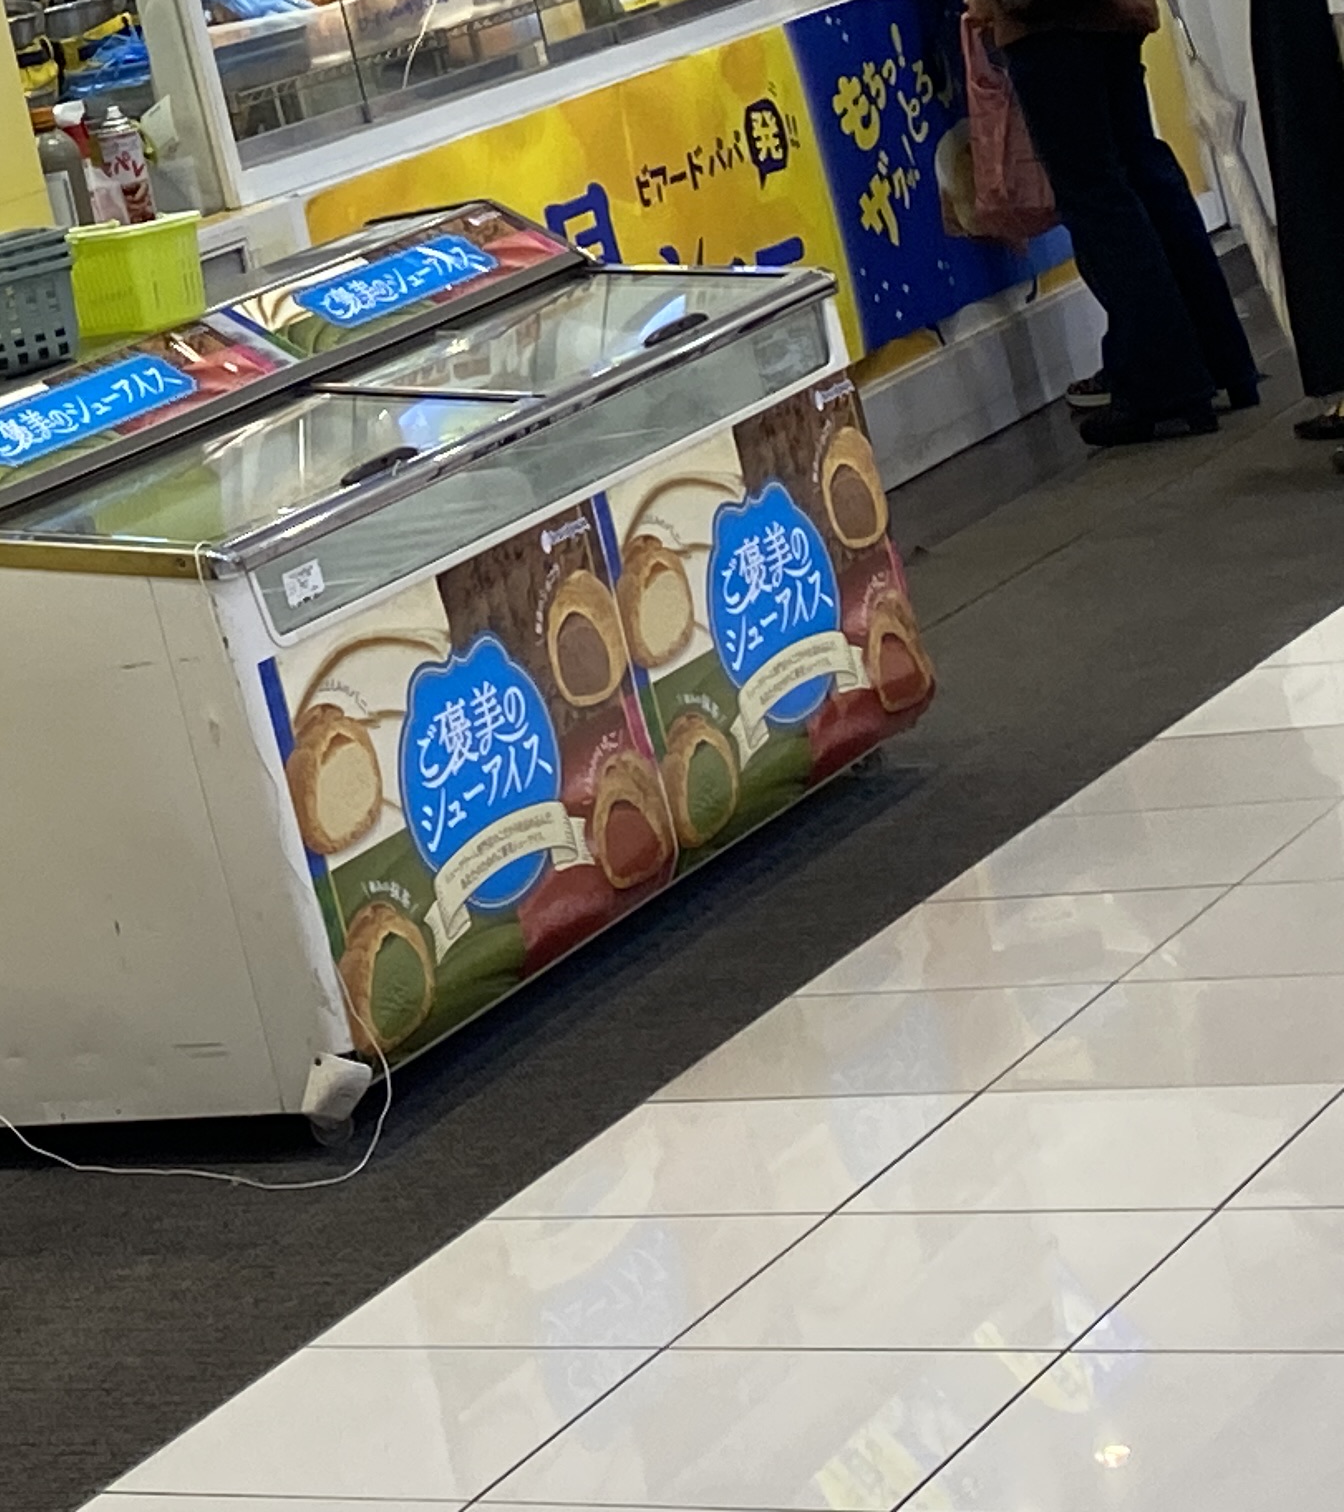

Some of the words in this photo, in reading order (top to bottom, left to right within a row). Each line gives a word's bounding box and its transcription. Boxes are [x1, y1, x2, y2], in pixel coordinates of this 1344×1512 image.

[722, 520, 814, 615] ご褒美の
[725, 570, 834, 672] シューアイス
[416, 680, 530, 790] ご褒美の
[421, 733, 555, 854] シューアイス
